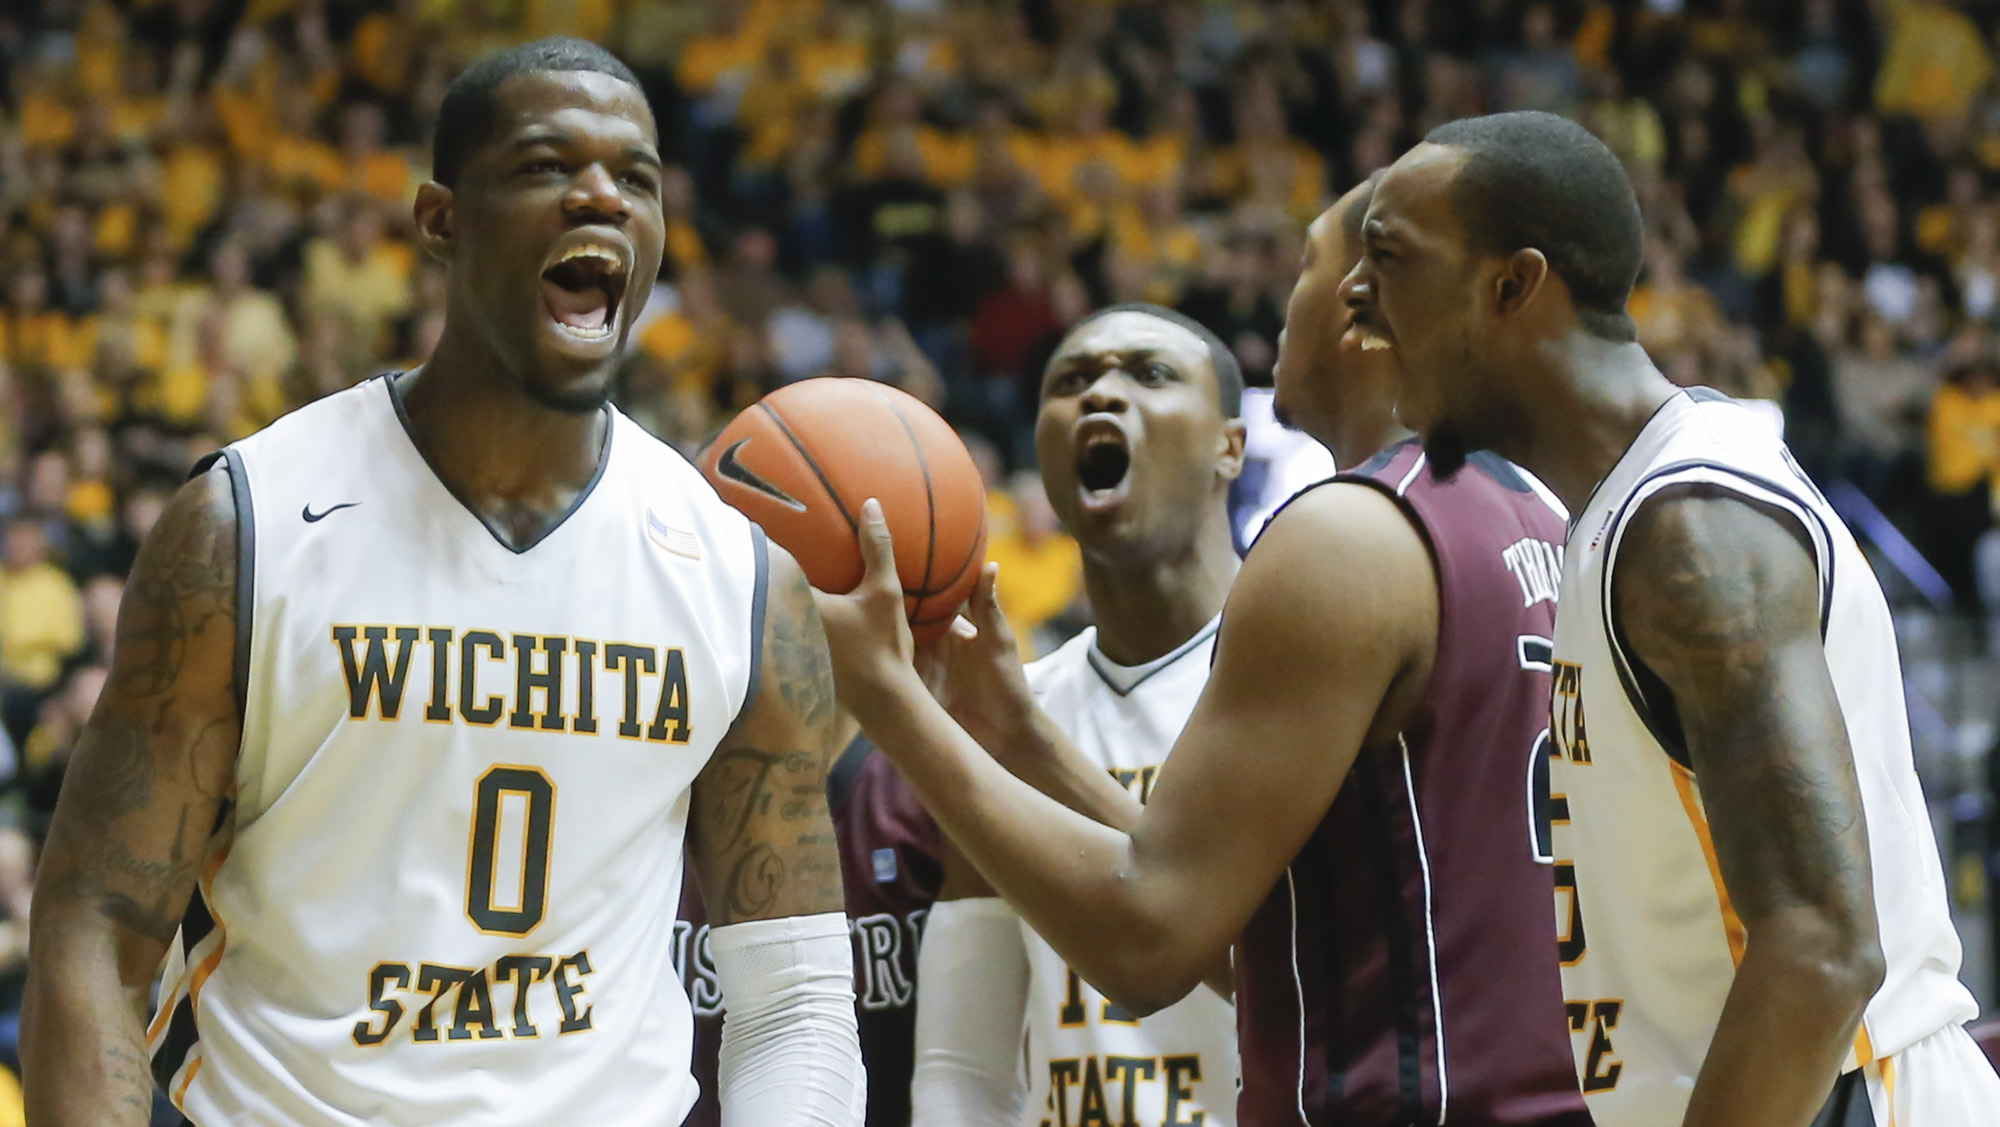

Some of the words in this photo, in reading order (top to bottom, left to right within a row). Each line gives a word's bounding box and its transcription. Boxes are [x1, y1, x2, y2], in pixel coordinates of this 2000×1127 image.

[331, 624, 693, 746] WICHITA
[463, 762, 558, 940] 0
[350, 948, 597, 1047] STATE
[1041, 1052, 1206, 1127] TATE
